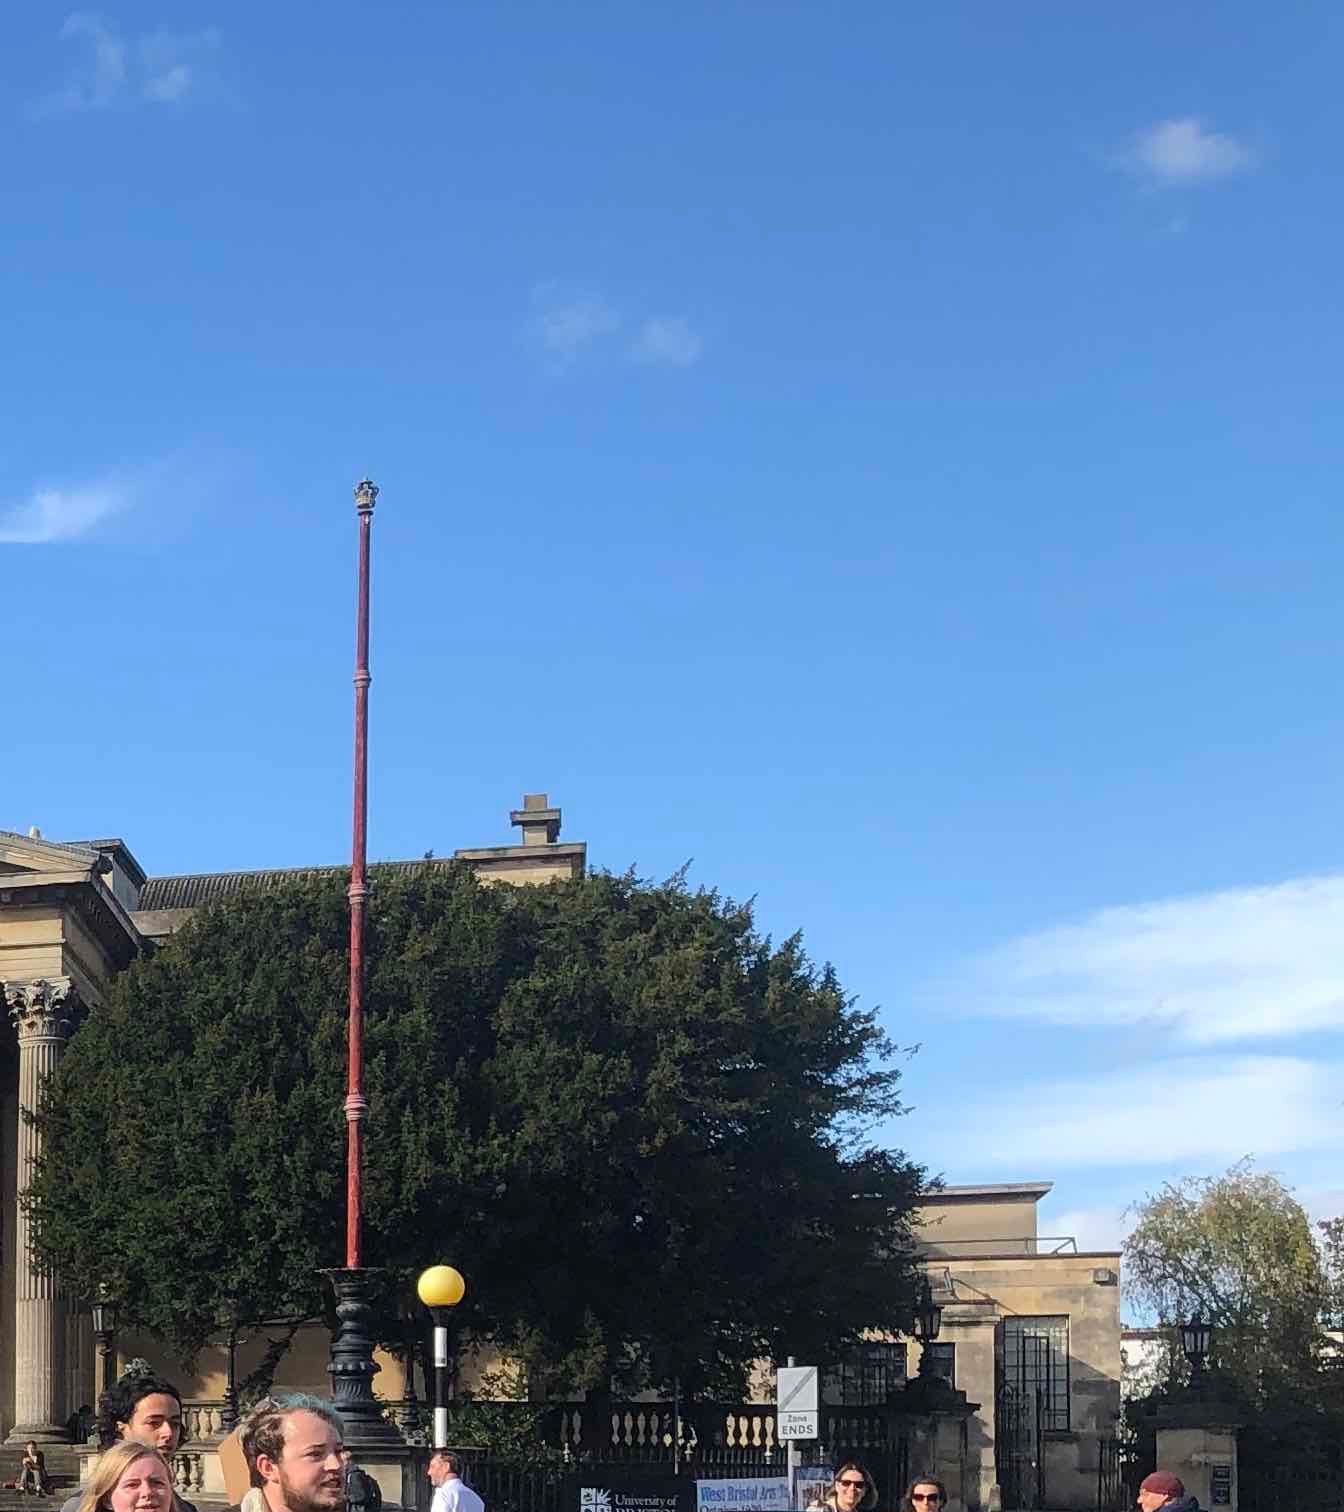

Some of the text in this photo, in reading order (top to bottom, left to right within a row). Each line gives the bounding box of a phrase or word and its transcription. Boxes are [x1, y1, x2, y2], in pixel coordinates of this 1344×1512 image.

[782, 1424, 814, 1435] ENDS
[615, 1494, 679, 1508] University of
